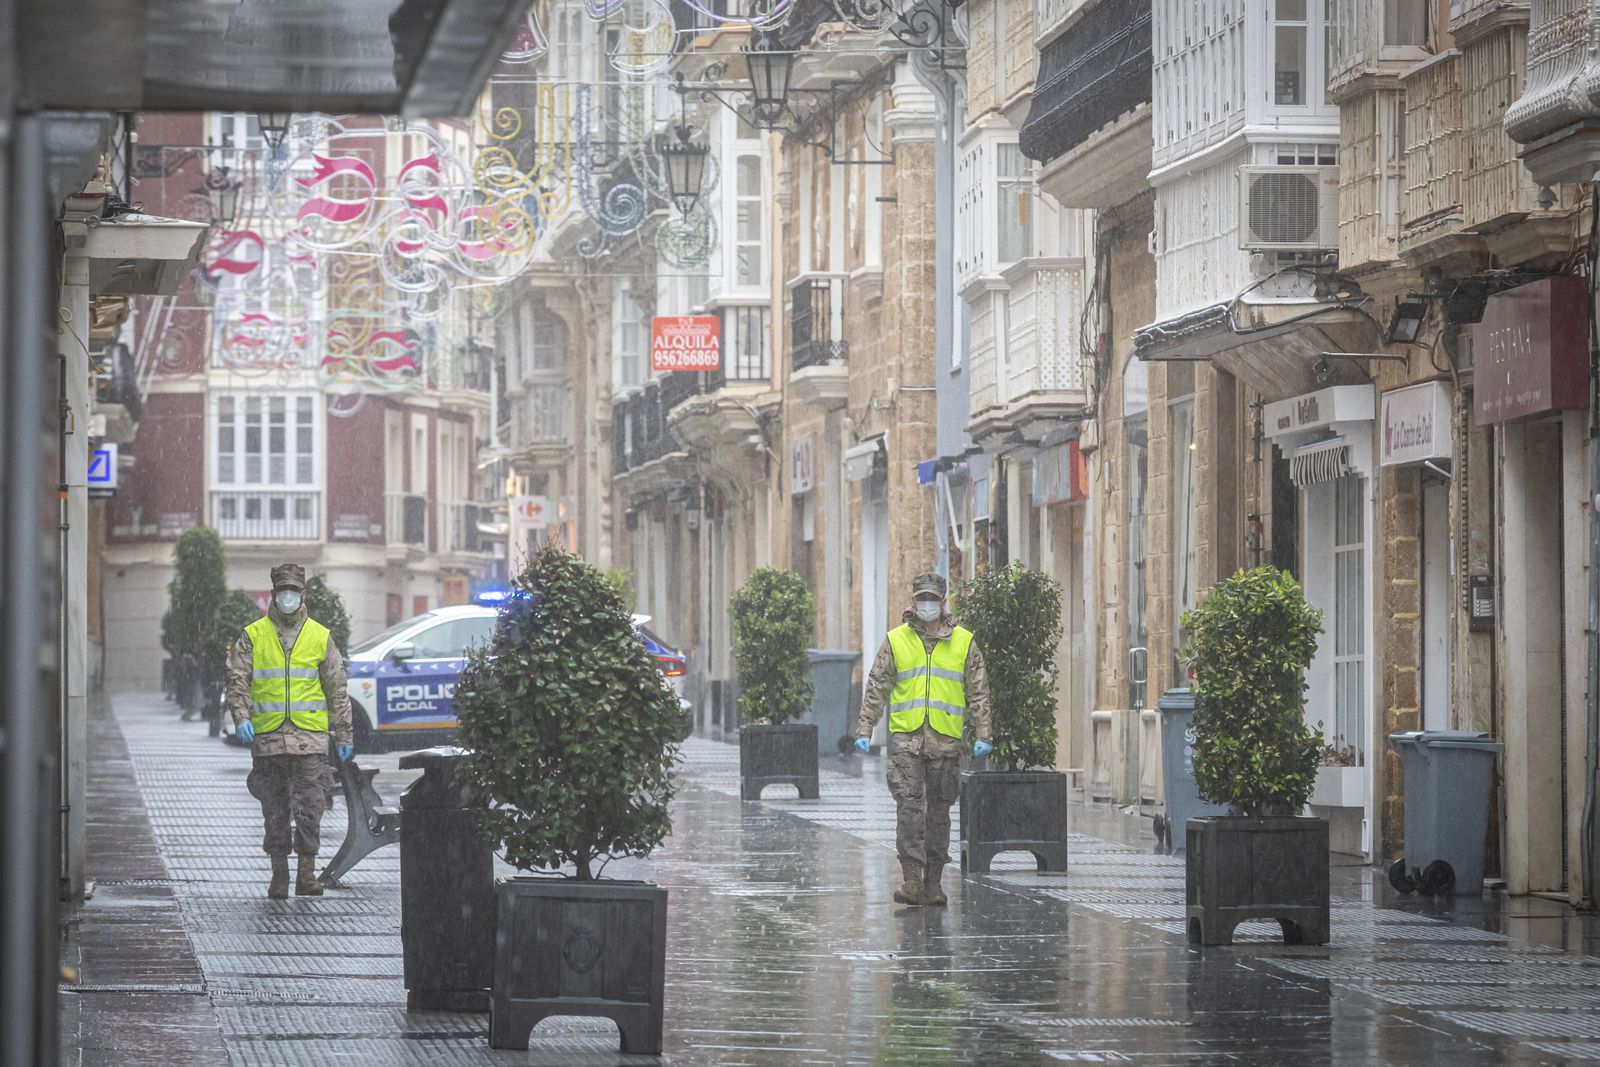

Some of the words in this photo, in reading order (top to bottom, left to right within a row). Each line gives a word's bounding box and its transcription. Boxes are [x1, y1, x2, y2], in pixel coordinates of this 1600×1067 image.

[653, 335, 720, 350] ALQUILA
[654, 349, 720, 366] 956266869
[386, 683, 461, 702] POLIC
[387, 701, 438, 712] LOCAL
